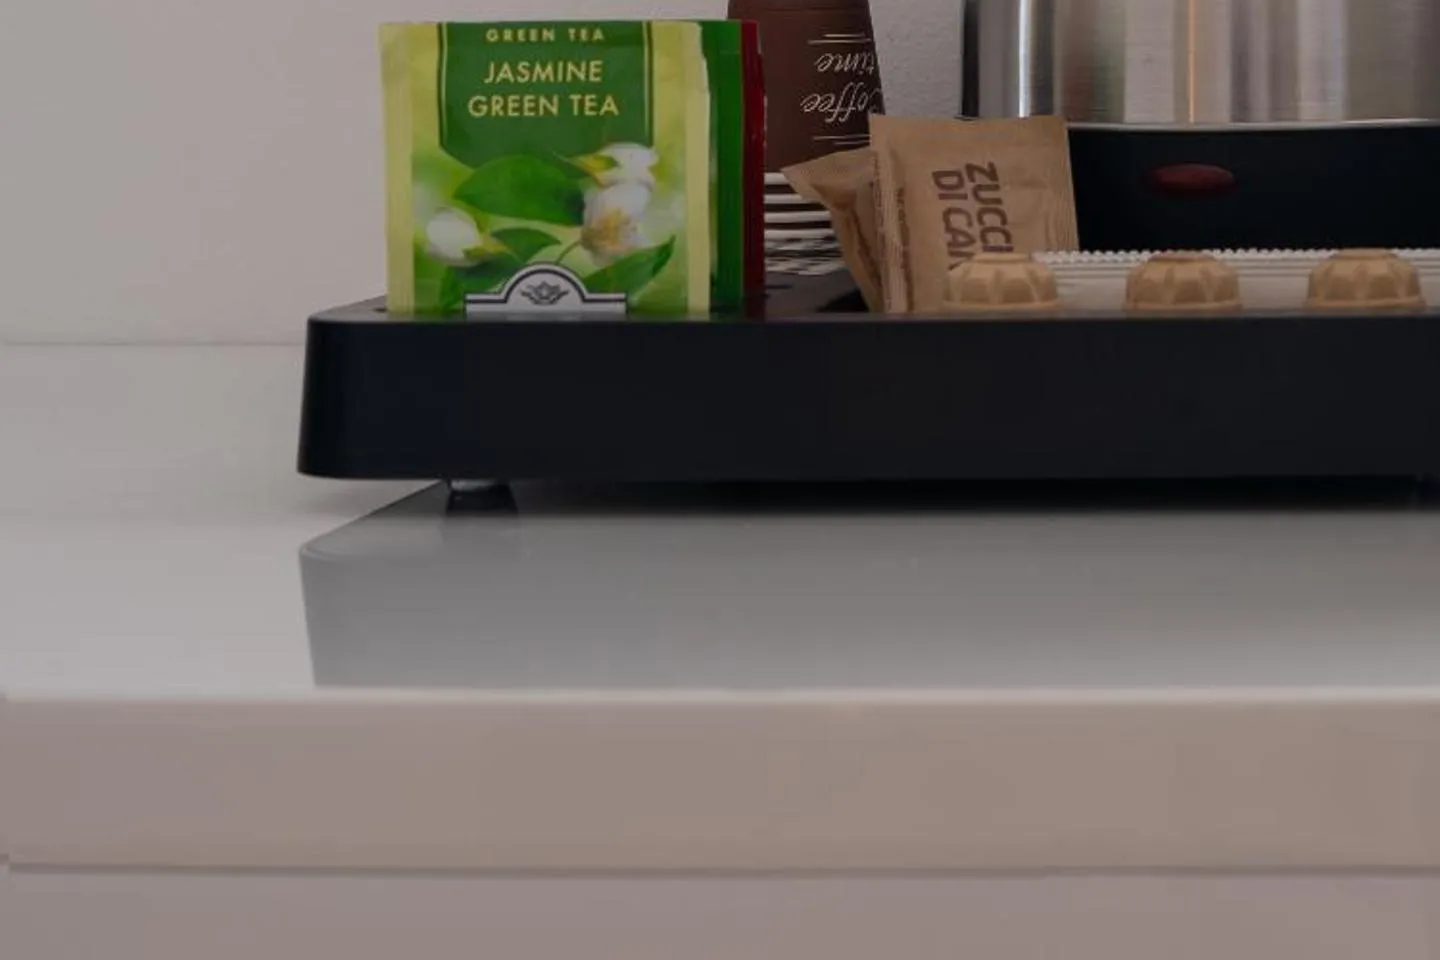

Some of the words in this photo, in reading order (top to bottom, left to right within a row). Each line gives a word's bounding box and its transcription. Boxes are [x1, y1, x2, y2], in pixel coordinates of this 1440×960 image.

[485, 27, 556, 42] GREEN
[567, 27, 605, 42] TEA
[483, 59, 604, 85] JASMINE
[813, 52, 875, 76] time
[467, 94, 560, 119] GREEN
[569, 93, 620, 117] TEA
[931, 169, 969, 201] DI
